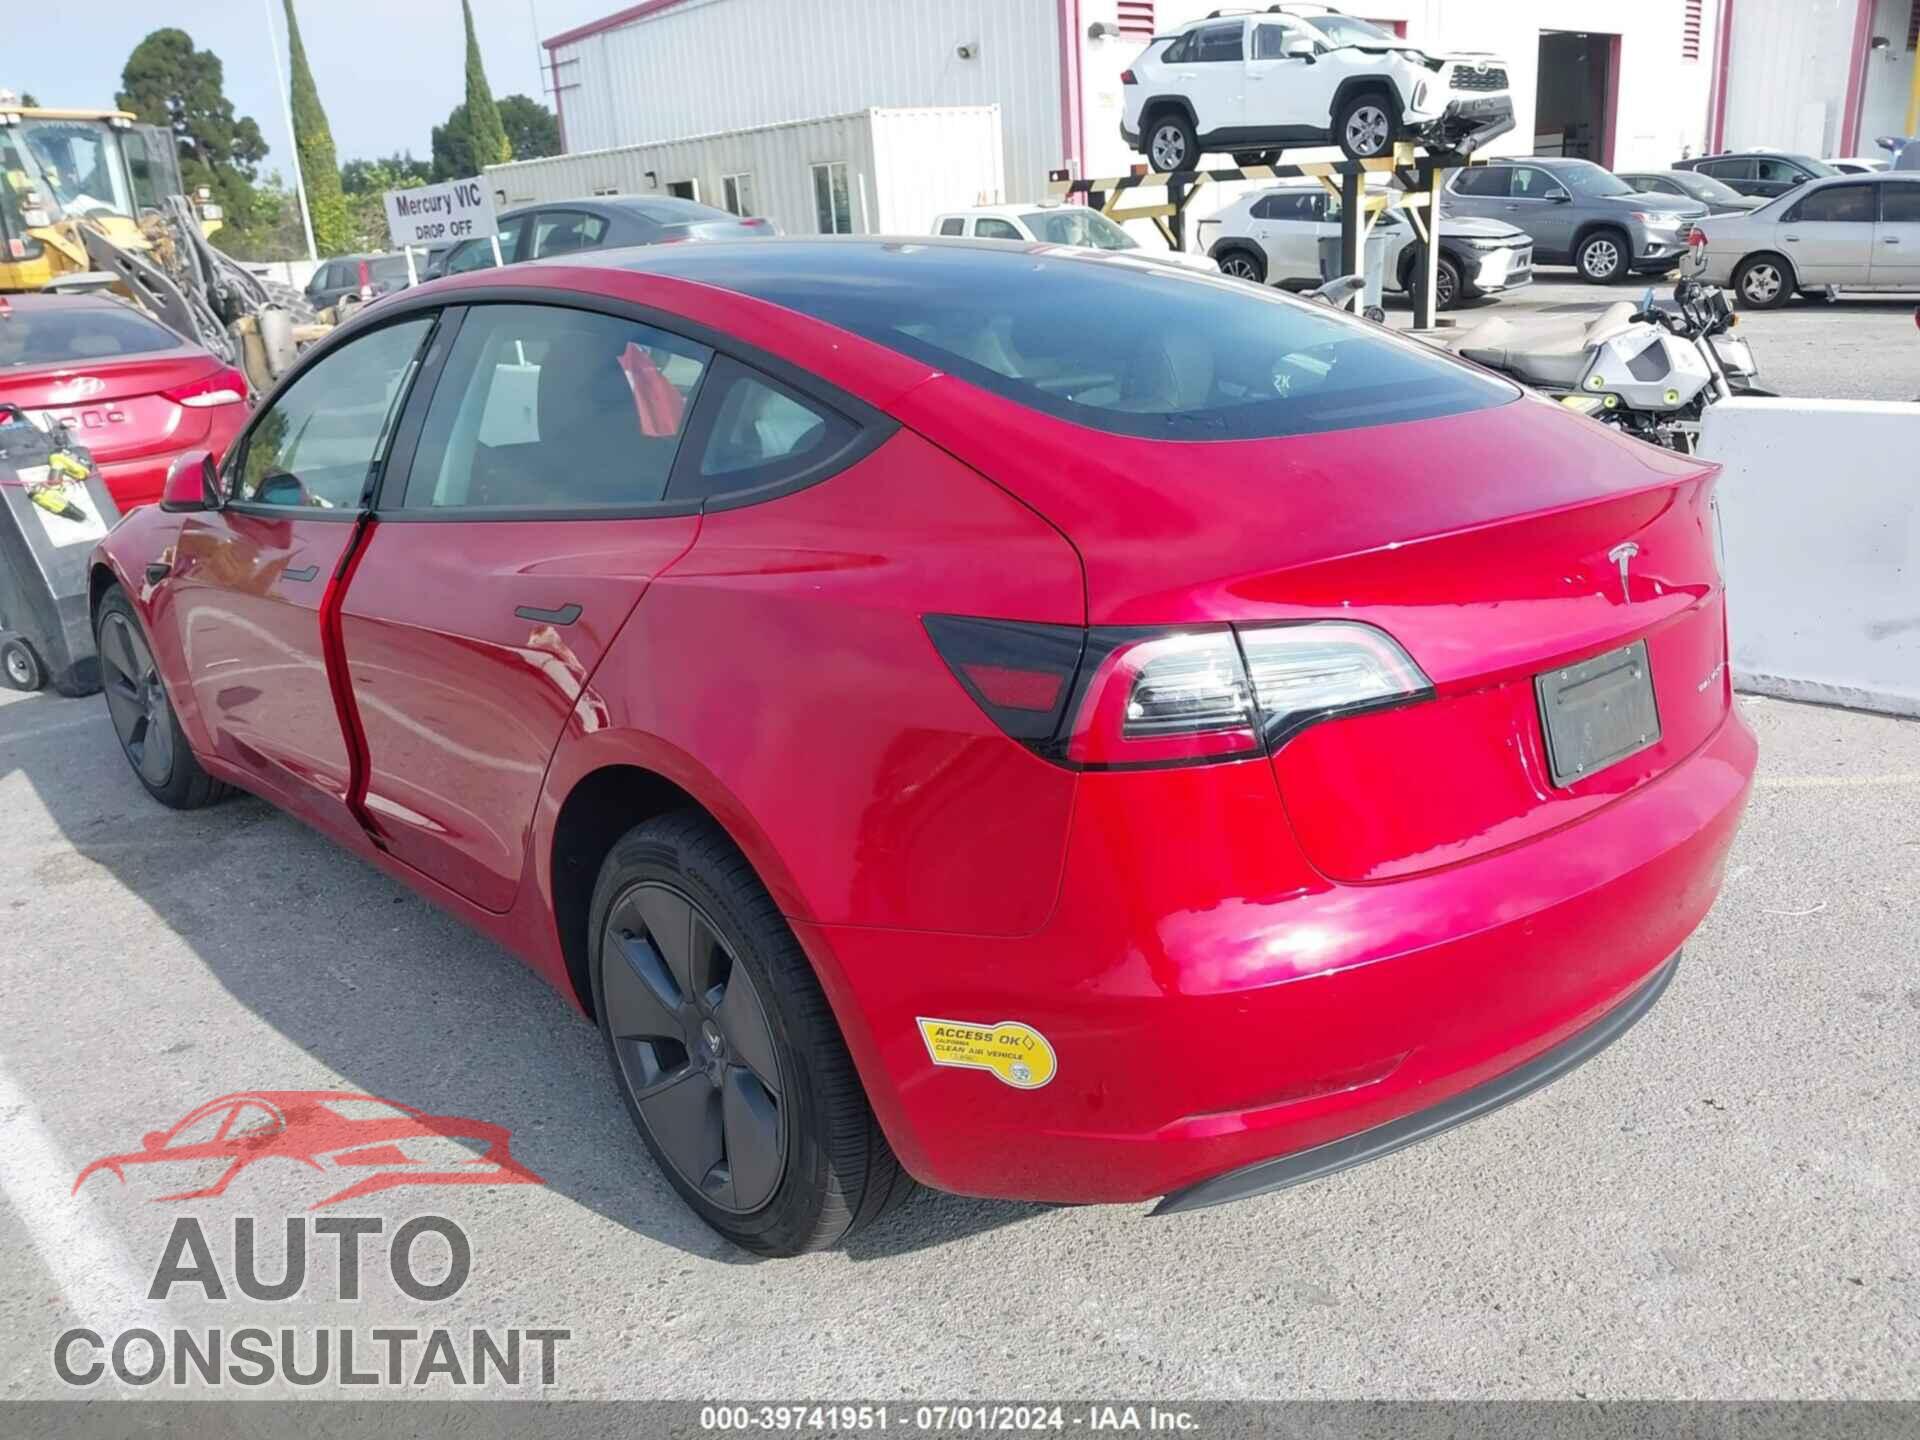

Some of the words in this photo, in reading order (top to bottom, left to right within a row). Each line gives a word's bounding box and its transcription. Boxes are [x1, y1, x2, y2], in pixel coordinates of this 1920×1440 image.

[396, 194, 452, 216] Mercury
[455, 183, 481, 208] VIC
[415, 223, 445, 240] DROP
[450, 219, 473, 236] OFF
[935, 1027, 994, 1042] ACCESS
[1000, 1035, 1020, 1046] OK
[935, 1044, 965, 1053] CLEAN
[968, 1047, 984, 1055] AIR
[986, 1049, 1024, 1060] VEHICLE
